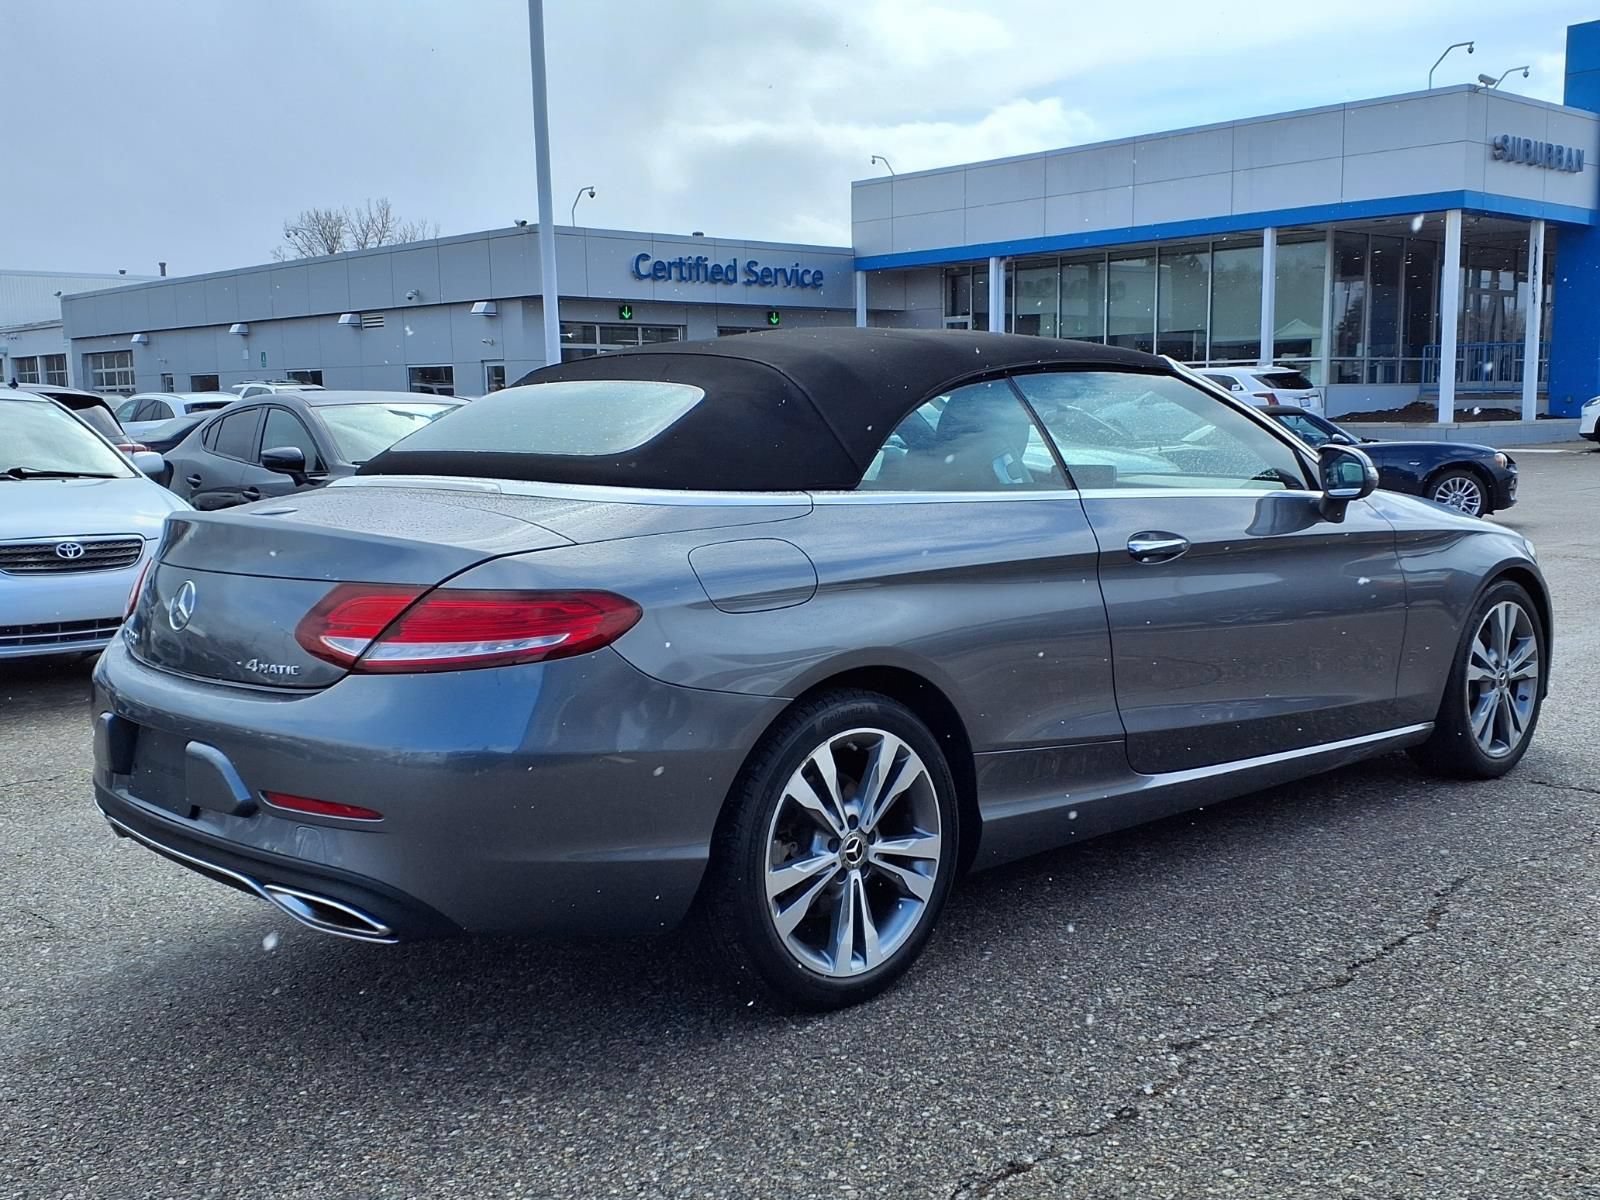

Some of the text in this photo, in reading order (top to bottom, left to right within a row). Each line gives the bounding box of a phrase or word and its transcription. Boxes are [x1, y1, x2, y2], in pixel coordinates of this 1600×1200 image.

[1493, 134, 1584, 173] SUBURBAN
[633, 253, 825, 289] Certified Service
[245, 658, 300, 675] 4MATIC
